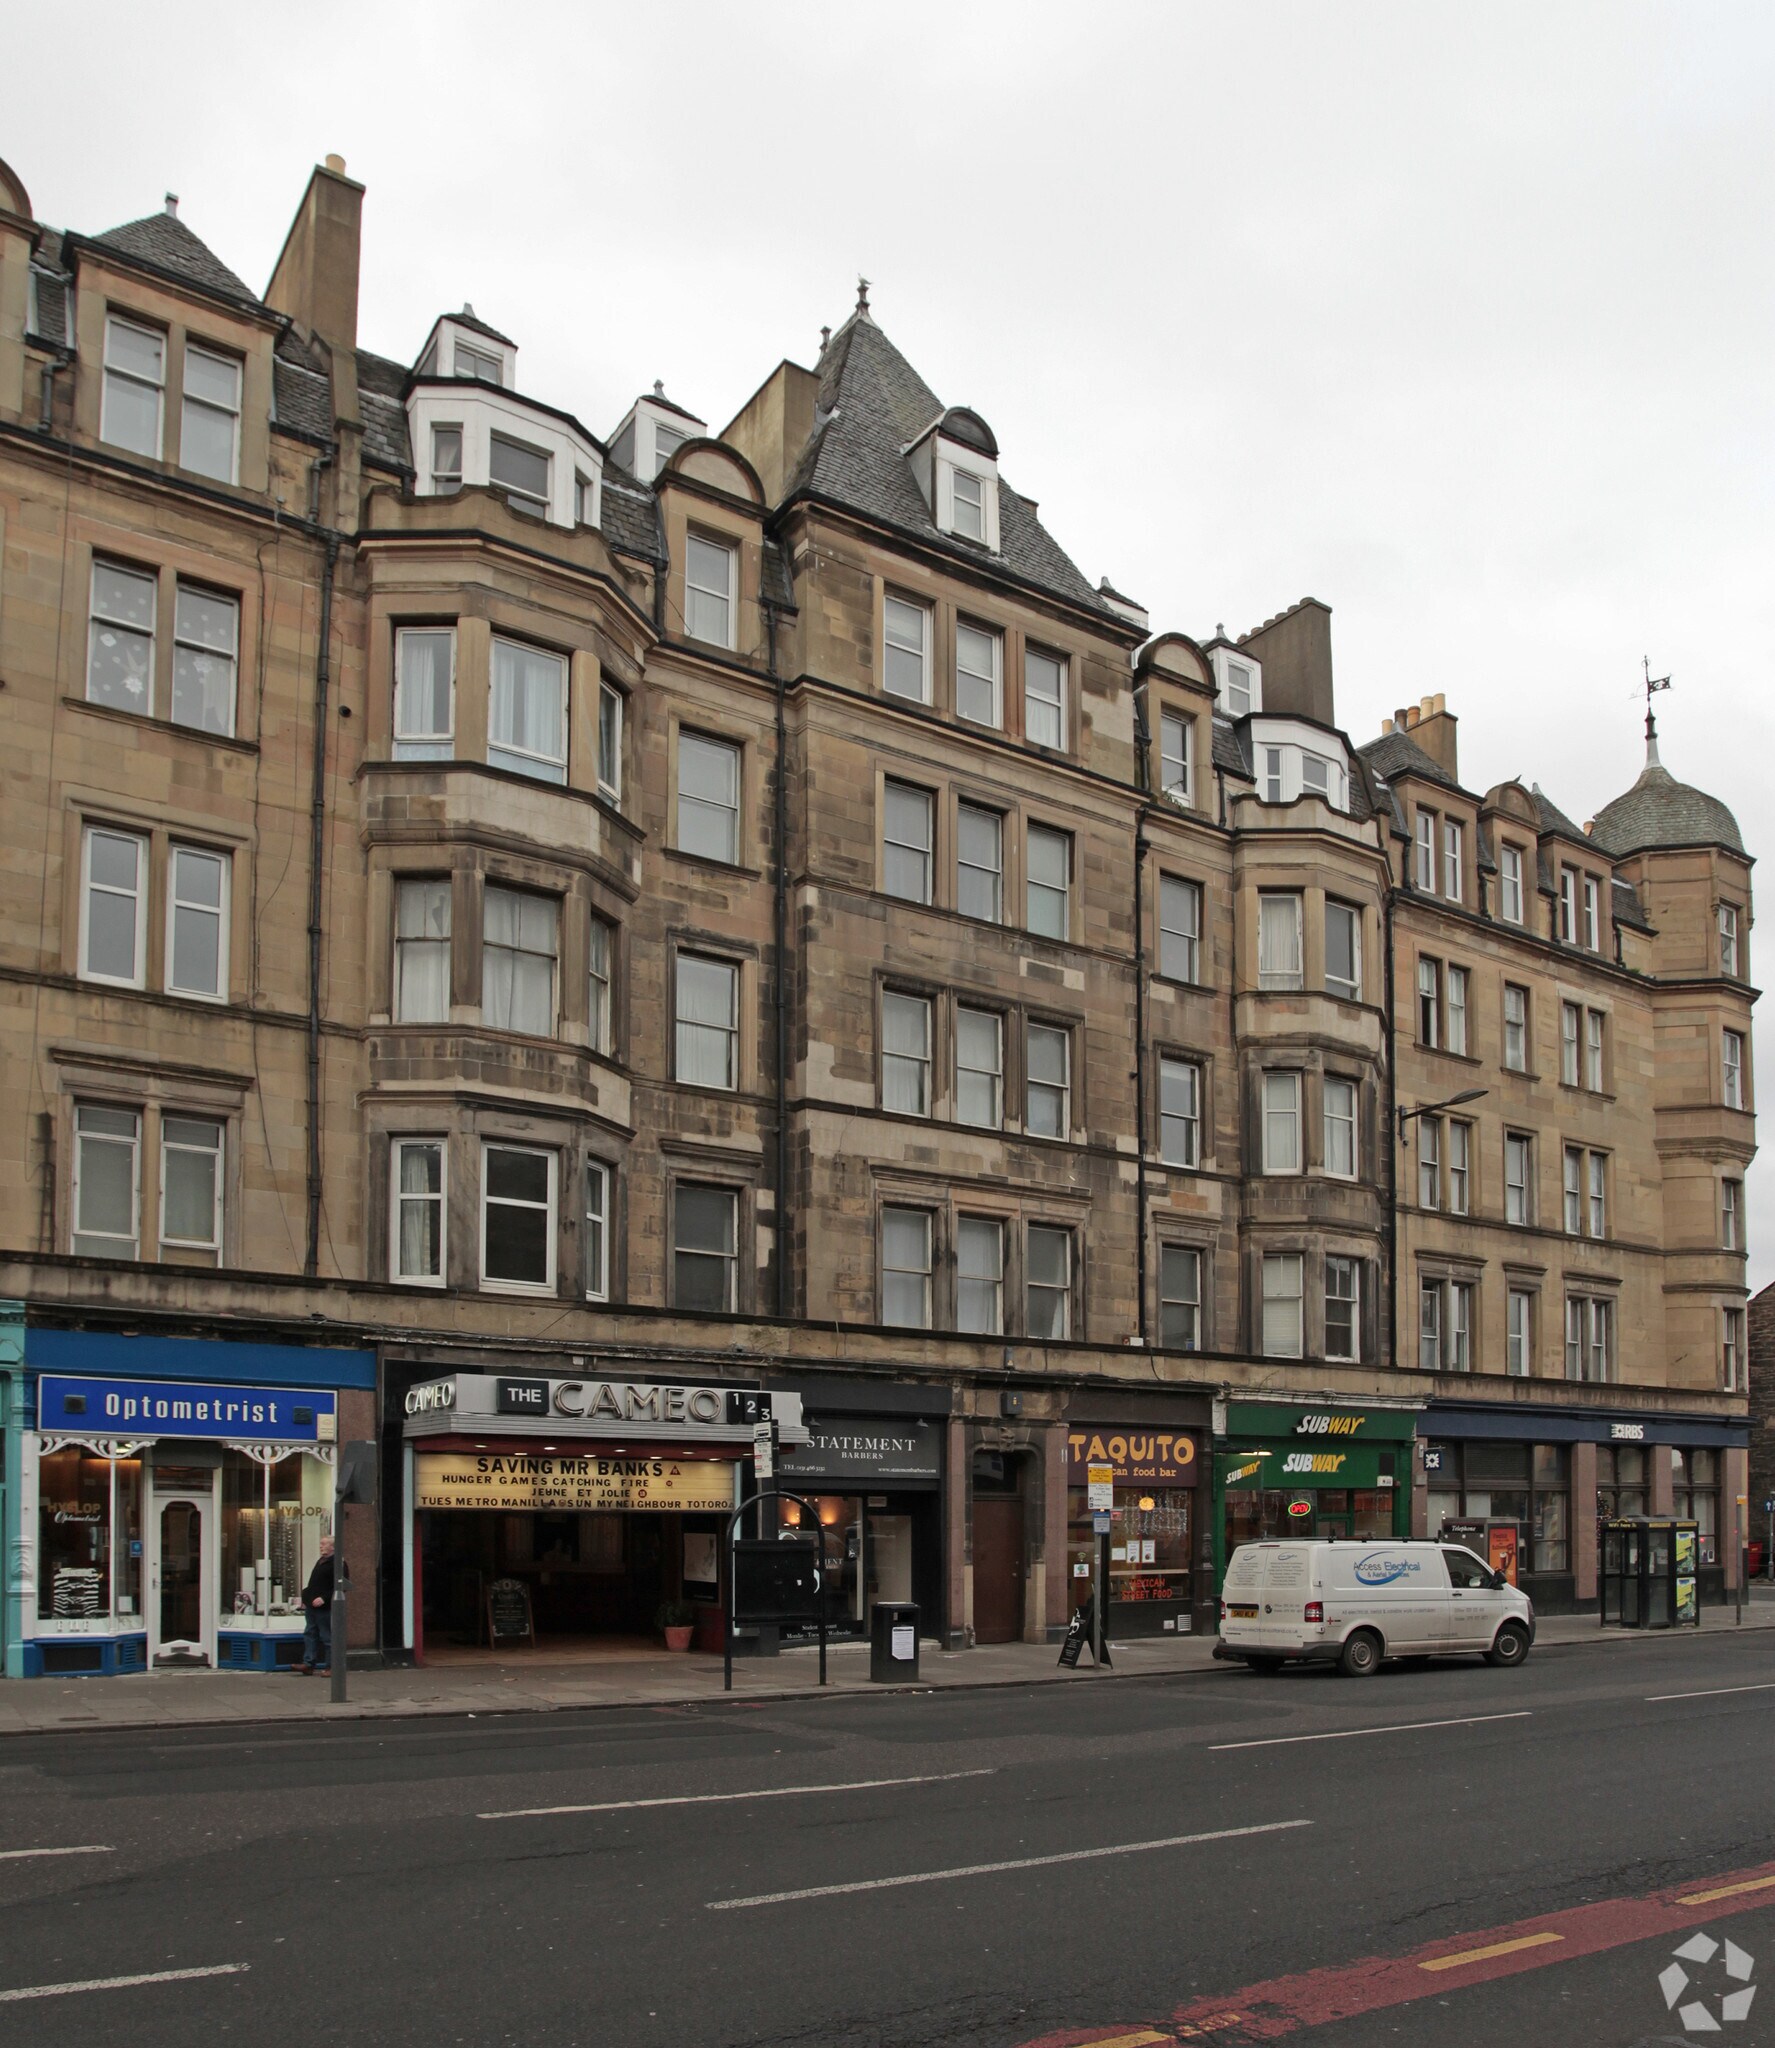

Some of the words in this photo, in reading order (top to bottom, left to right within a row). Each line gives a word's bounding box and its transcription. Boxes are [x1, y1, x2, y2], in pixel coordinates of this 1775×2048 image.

[405, 1382, 453, 1413] CAMEO
[507, 1387, 542, 1403] THE
[554, 1381, 721, 1422] CAMEO
[105, 1393, 278, 1423] Optometrist
[733, 1392, 739, 1405] 1
[747, 1400, 756, 1413] 2
[761, 1408, 770, 1421] 3
[1297, 1415, 1365, 1435] SUBWAY
[1625, 1424, 1644, 1440] RBS
[806, 1435, 916, 1451] STATEMENT
[1068, 1434, 1194, 1464] TAQUITO
[841, 1451, 884, 1460] BARBERS
[1282, 1453, 1347, 1473] SUBWAY
[477, 1457, 553, 1475] SAVING
[560, 1459, 589, 1476] MR
[597, 1461, 663, 1477] BANKS
[1133, 1467, 1156, 1477] food
[1159, 1467, 1177, 1477] bar
[1225, 1460, 1261, 1485] SUBWAY
[442, 1475, 492, 1484] HUNGER
[499, 1476, 548, 1485] GAMES
[552, 1477, 611, 1487] CATCHING
[621, 1479, 649, 1487] FIRE
[577, 1489, 592, 1497] ET
[600, 1489, 630, 1498] JOLIE
[47, 1501, 101, 1515] HYSLOP
[421, 1496, 452, 1506] TUES
[455, 1497, 498, 1506] METRO
[501, 1498, 557, 1507] MANILLA
[567, 1499, 592, 1507] SUN
[597, 1499, 613, 1508] MY
[615, 1500, 681, 1509] NEIGHBOUR
[687, 1500, 728, 1509] TOTORO
[54, 1511, 102, 1524] Optometrist
[1451, 1525, 1486, 1533] Telephone
[1353, 1561, 1382, 1571] Access
[1384, 1559, 1421, 1571] Electrical
[1129, 1578, 1166, 1588] MEXICAN
[1121, 1589, 1149, 1600] STREET
[1152, 1588, 1173, 1599] FOOD
